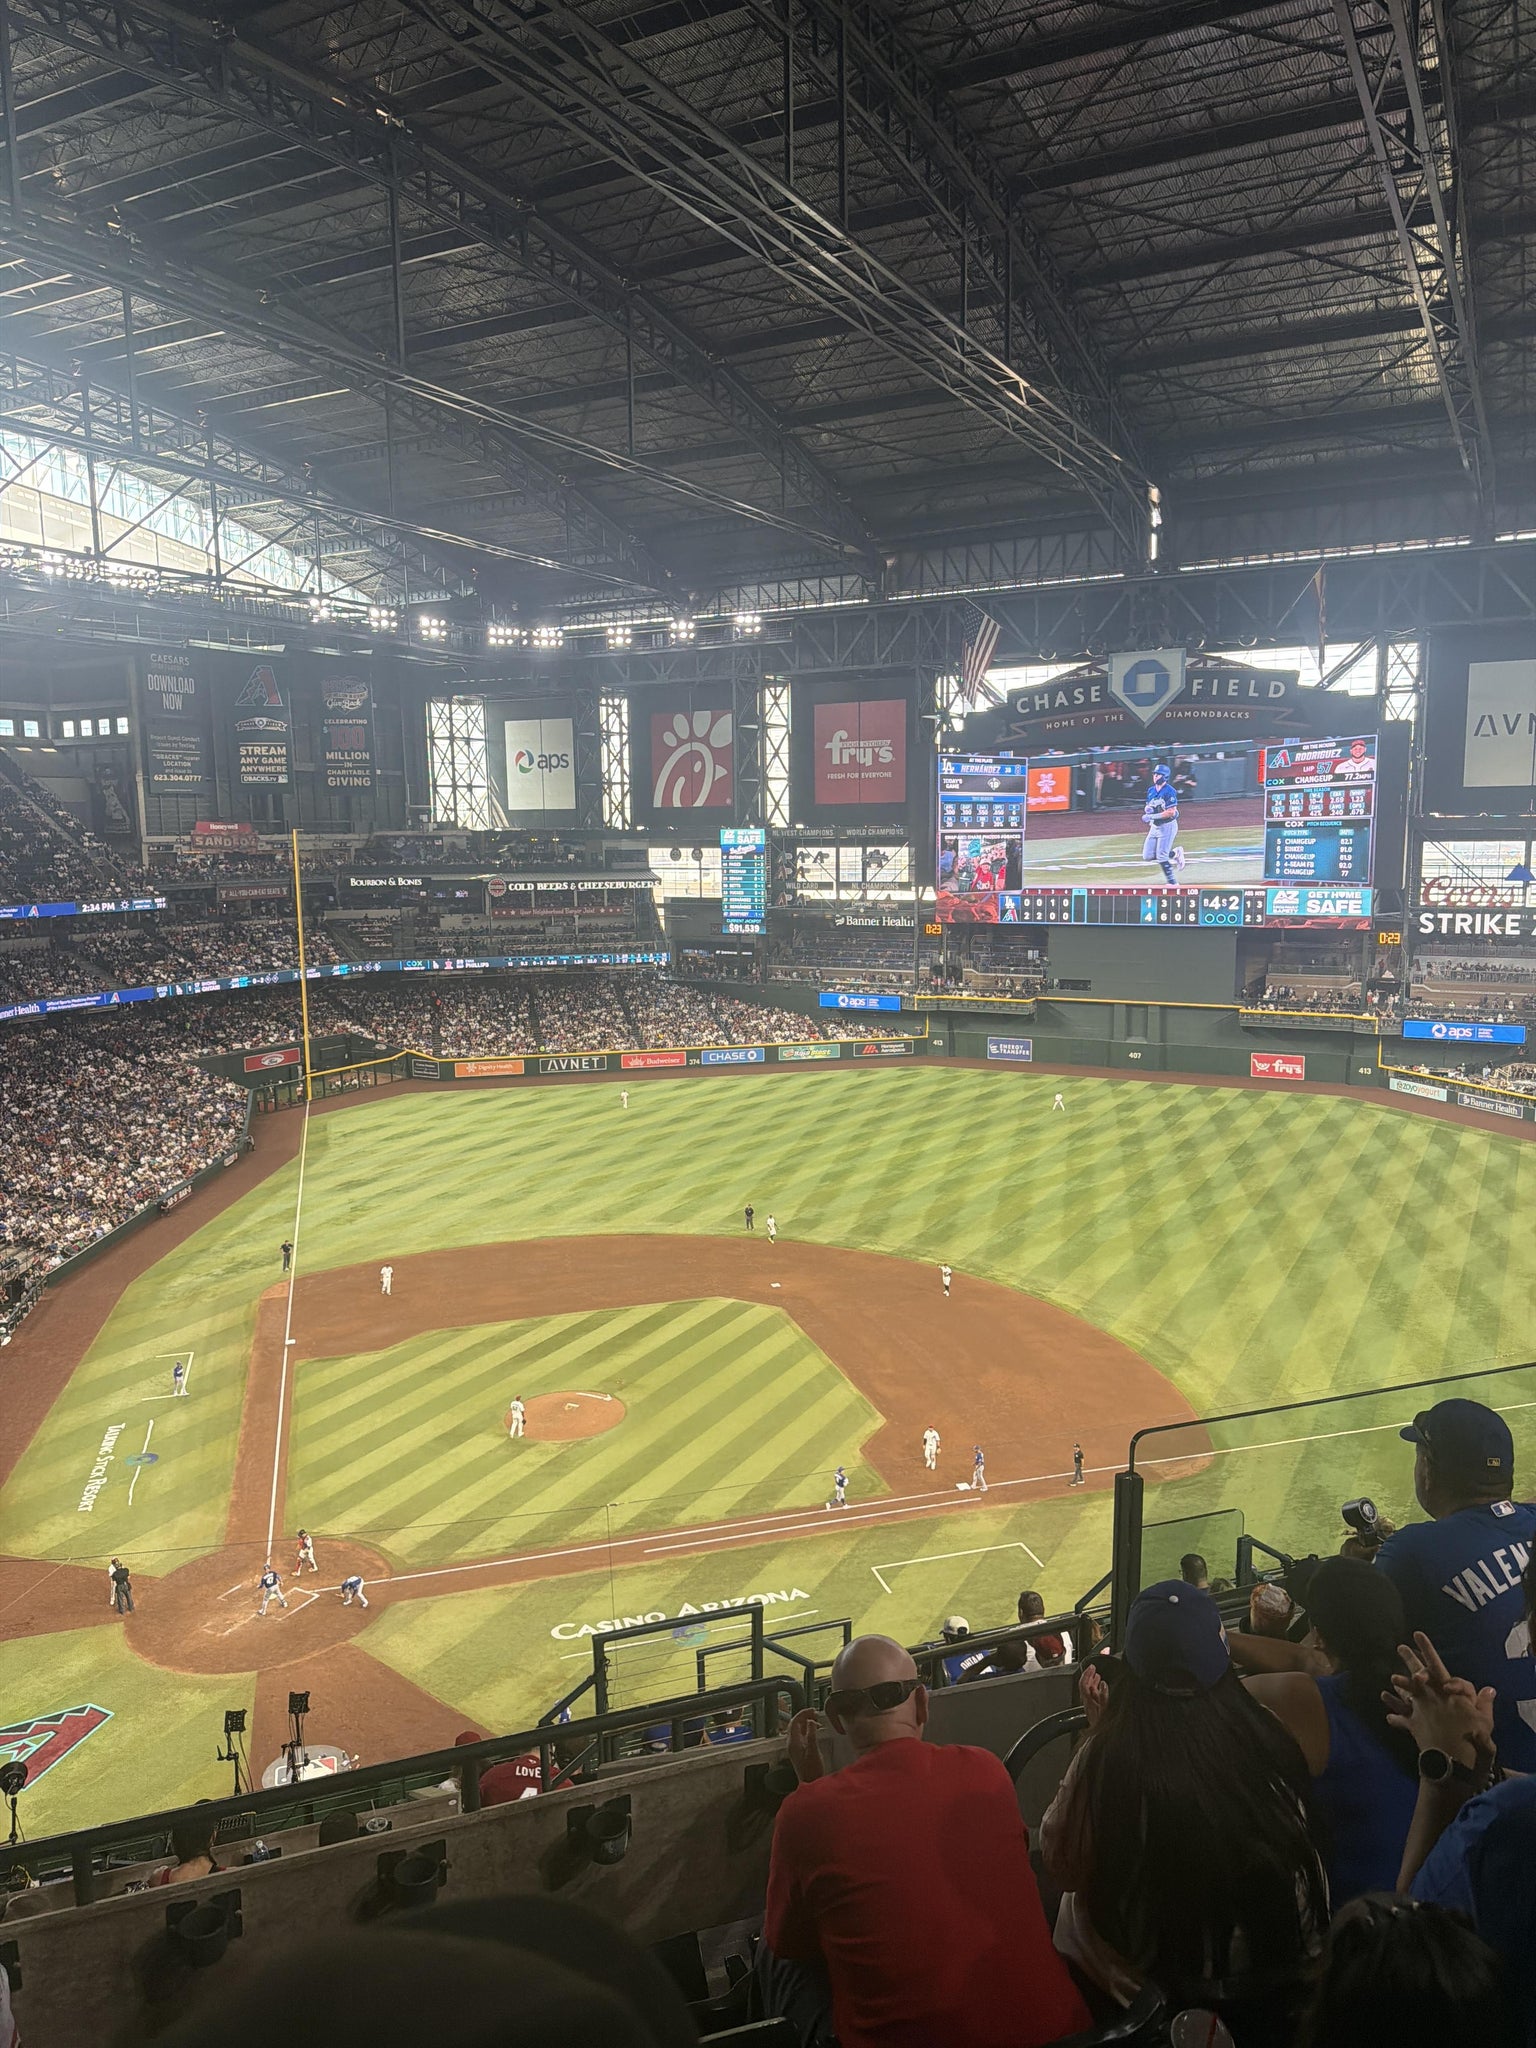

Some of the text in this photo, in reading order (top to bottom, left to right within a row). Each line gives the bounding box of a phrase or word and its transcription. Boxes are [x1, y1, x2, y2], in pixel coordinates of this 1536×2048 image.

[150, 654, 190, 666] CAESARS
[148, 674, 194, 694] DOWNLOAD
[162, 693, 182, 710] NOW
[1016, 678, 1286, 714] CHASE FIELD
[1046, 719, 1075, 729] HOME
[1104, 714, 1124, 722] THE
[1166, 711, 1250, 719] DIAMONDBACKS
[240, 746, 286, 756] STREAM
[824, 730, 894, 766] fry's
[326, 752, 370, 760] MILLION
[1295, 749, 1342, 762] RODRIGUEZ
[538, 754, 569, 772] aps
[1316, 762, 1333, 774] 57
[154, 774, 202, 782] 623.304.0777
[328, 777, 371, 786] GIVING
[1266, 778, 1285, 786] COX
[1295, 775, 1333, 784] CHANGEUP
[737, 836, 762, 844] SAFE
[388, 878, 396, 886] &
[508, 880, 660, 891] COLD BEERS & CHEESEBURGERS
[862, 882, 899, 890] CHAMPIONS
[1420, 876, 1514, 908] Coors
[82, 902, 116, 912] 2:34 PM
[1024, 898, 1196, 908] 0 0 1 0 1 3 1 3
[1209, 896, 1220, 910] 4
[1228, 896, 1240, 910] 2
[1306, 900, 1362, 914] SAFE
[846, 916, 914, 926] Banner Health
[1024, 912, 1196, 922] 2 2 0 0 4 6 0 6
[1245, 914, 1262, 922] 2 3
[729, 923, 760, 933] $91,539
[926, 924, 942, 934] 0:23
[1419, 912, 1521, 935] STRIKE
[1380, 932, 1400, 944] 0:23
[850, 998, 866, 1007] aps
[14, 1004, 40, 1015] Health
[1448, 1027, 1472, 1038] aps
[709, 1052, 746, 1061] CHASE
[548, 1057, 599, 1070] AVNET
[1272, 1060, 1302, 1074] fry's
[1470, 1097, 1518, 1115] Banner Health
[90, 1456, 114, 1478] STICK
[78, 1477, 107, 1512] RESORT
[1442, 1540, 1534, 1612] VALEN
[550, 1588, 810, 1640] CASINO ARIZONA
[516, 1766, 542, 1778] LOVE
